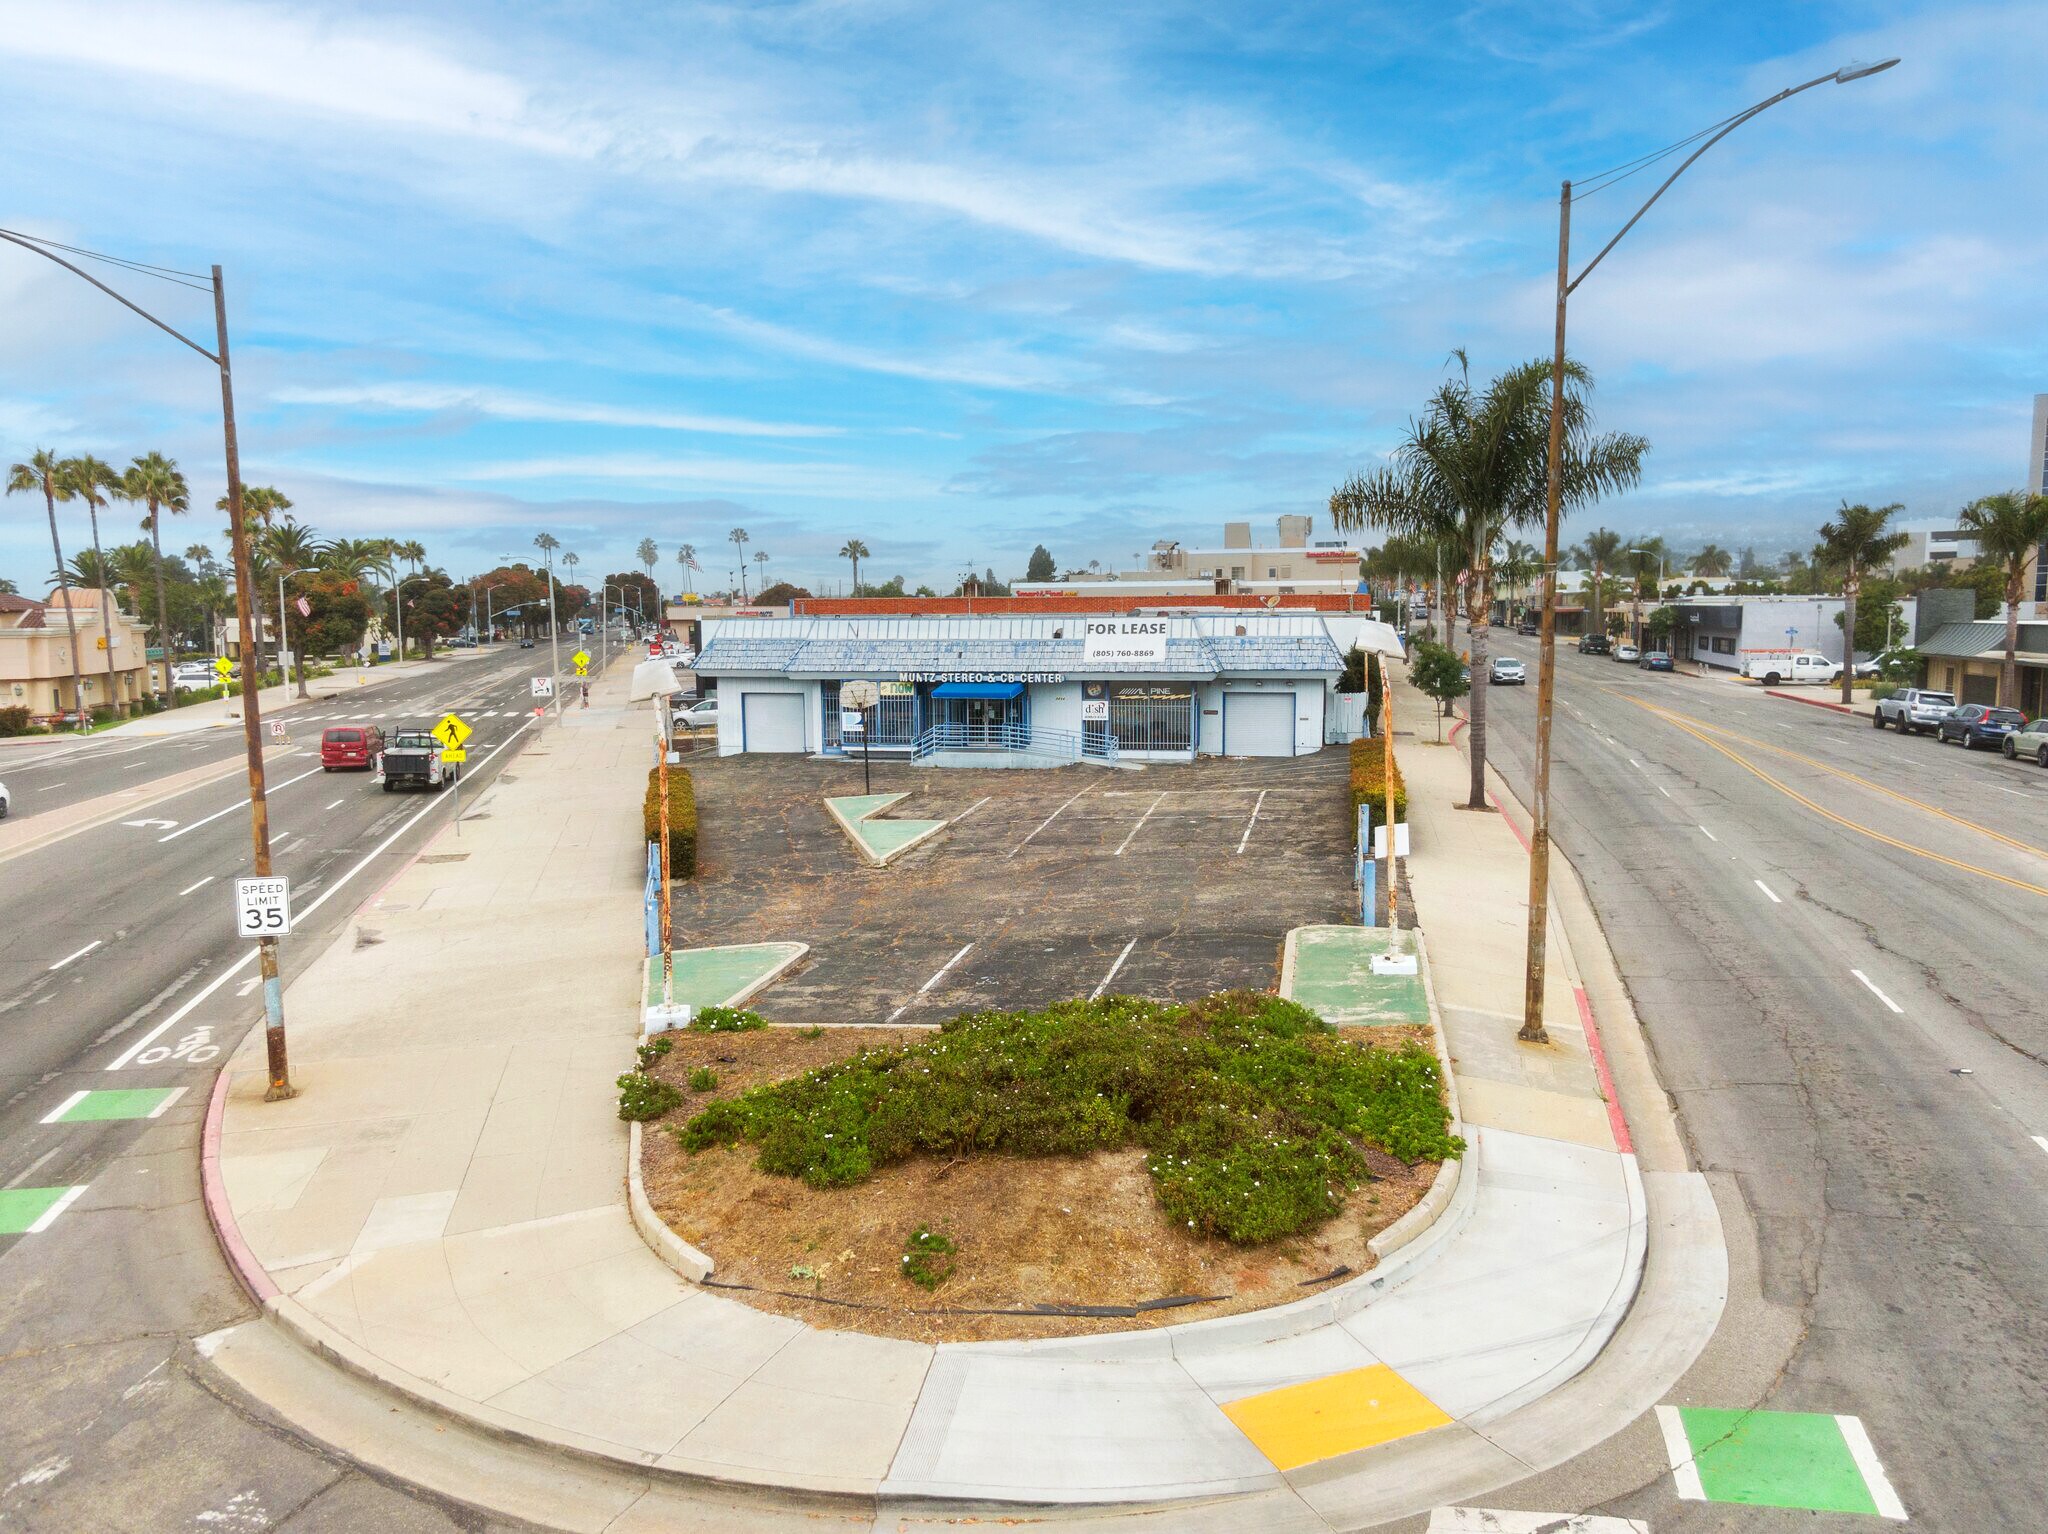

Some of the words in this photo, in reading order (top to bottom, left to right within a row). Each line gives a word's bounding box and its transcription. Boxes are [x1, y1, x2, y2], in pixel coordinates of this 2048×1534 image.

[1087, 623, 1117, 635] FOR
[1122, 623, 1167, 635] LEASE
[1092, 650, 1114, 658] (805)
[1116, 649, 1155, 657] 760-8869
[899, 672, 936, 682] MUNTZ
[941, 672, 983, 683] STEREO
[987, 672, 997, 683] &
[1000, 673, 1016, 683] CB
[1020, 672, 1063, 683] CENTER
[445, 752, 464, 760] AHEAD
[241, 884, 284, 895] SPEED
[246, 895, 279, 906] LIMIT
[245, 907, 284, 929] 35
